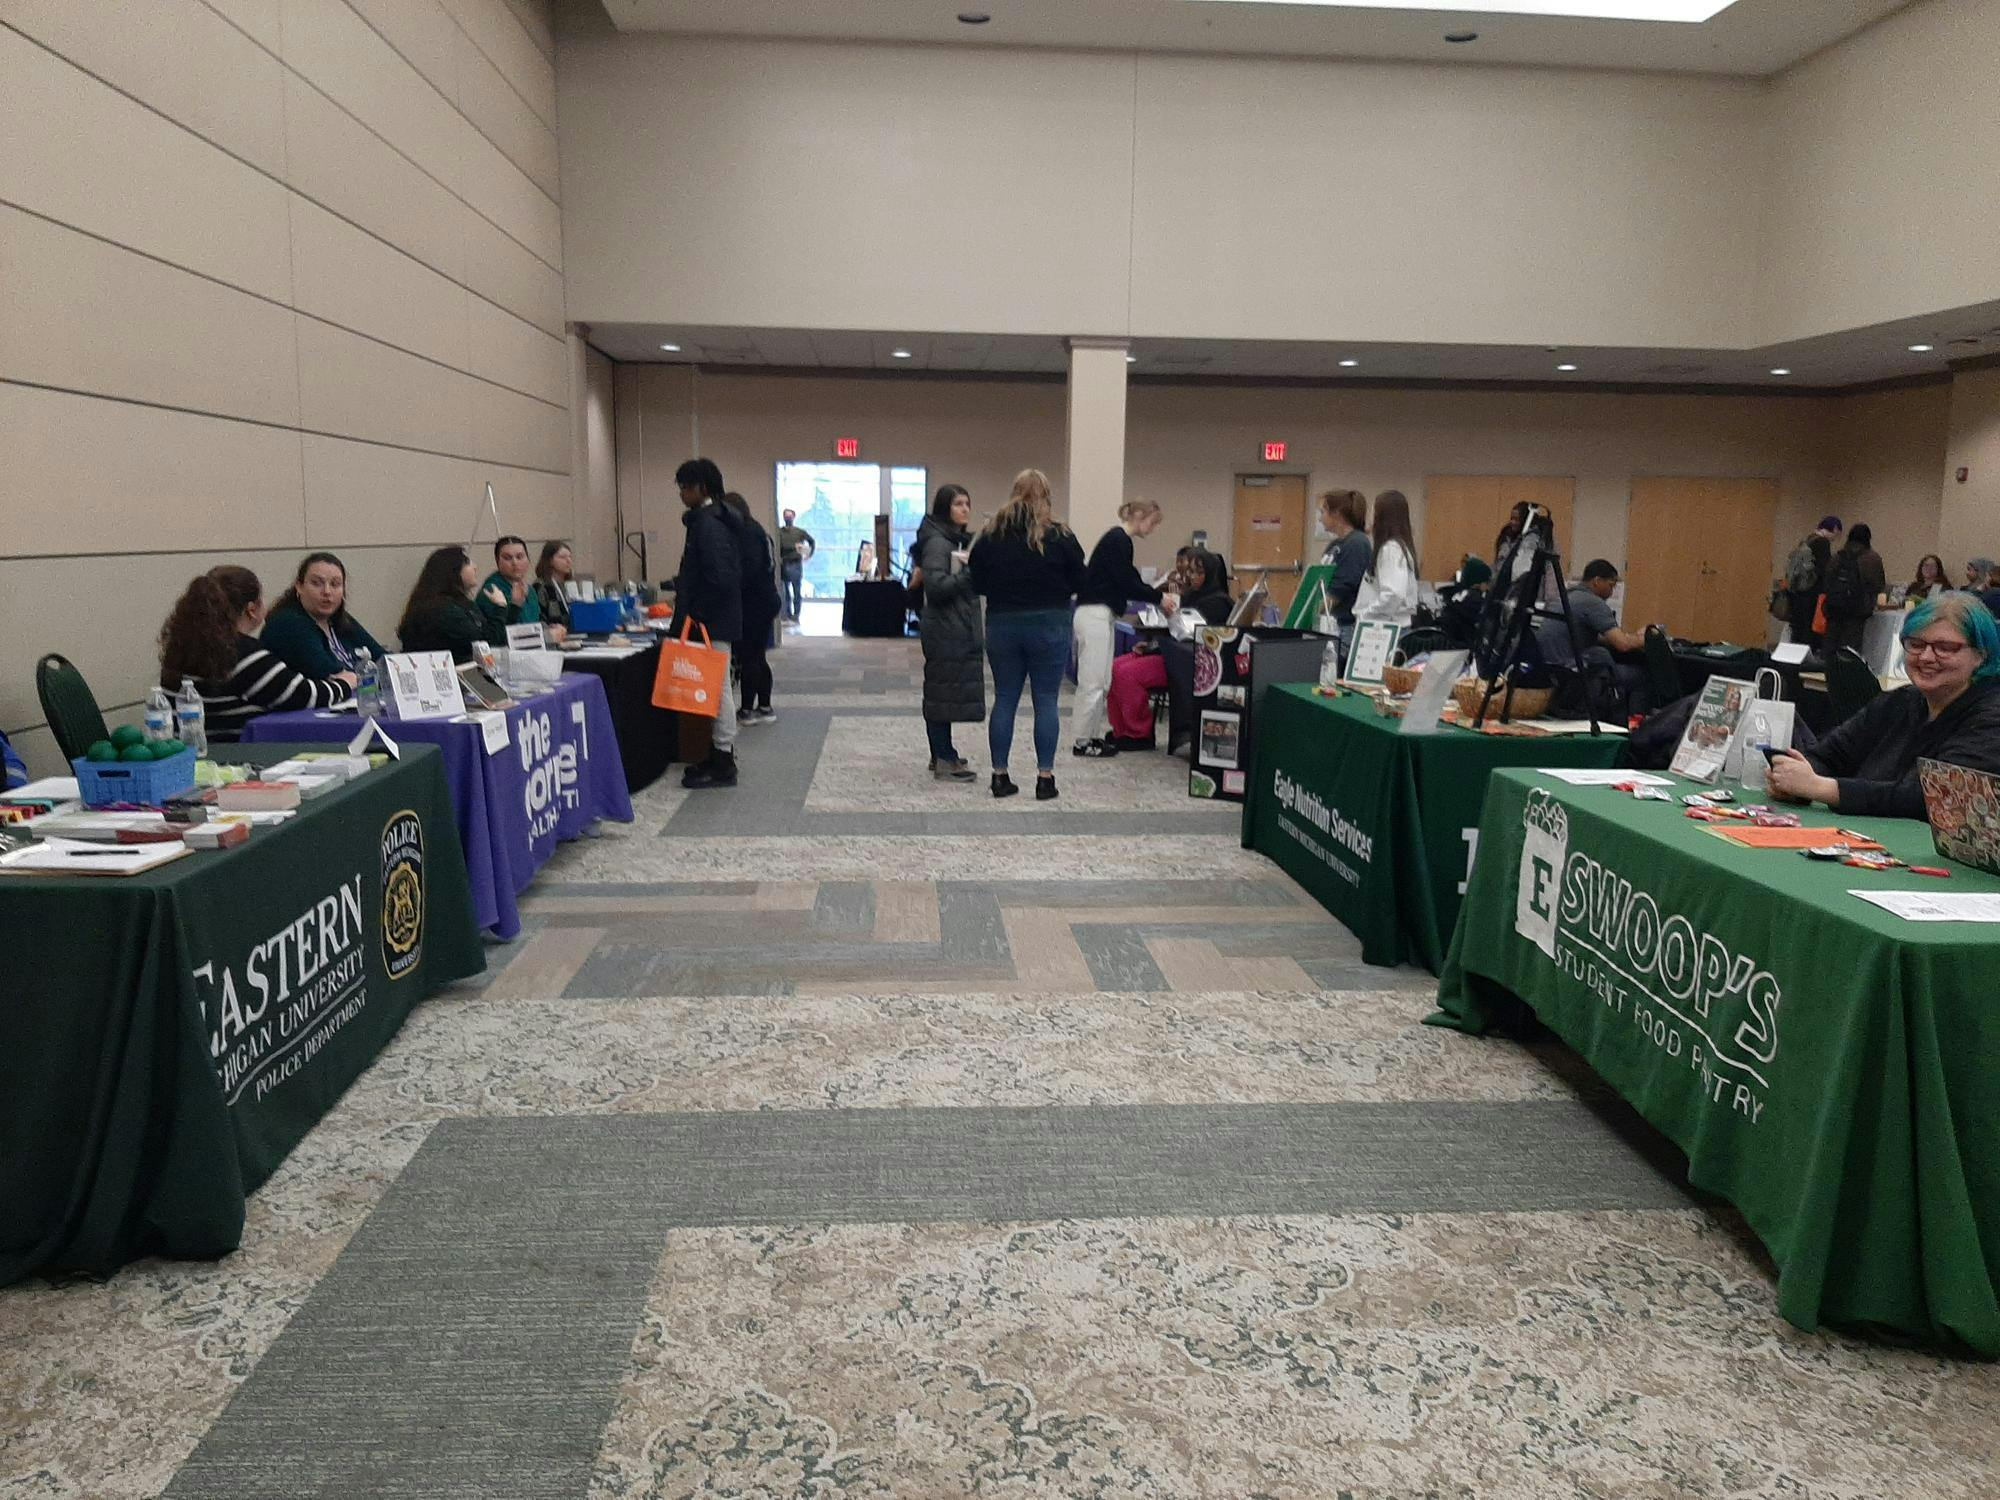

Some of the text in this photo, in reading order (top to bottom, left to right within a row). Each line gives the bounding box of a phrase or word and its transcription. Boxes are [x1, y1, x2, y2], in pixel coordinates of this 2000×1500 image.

[837, 439, 857, 457] EXIT
[1265, 443, 1285, 461] EXIT
[518, 709, 551, 772] the
[382, 820, 418, 863] POLICE
[1274, 768, 1373, 863] Eagle Nutrition Services
[1555, 944, 1628, 1013] STUDENT
[1634, 1001, 1682, 1056] FOOD
[1561, 851, 1781, 1063] SWOOP'S
[217, 943, 365, 1093] HIGAN UNIVERSITY
[255, 988, 367, 1102] POLICE DEPARTMENT
